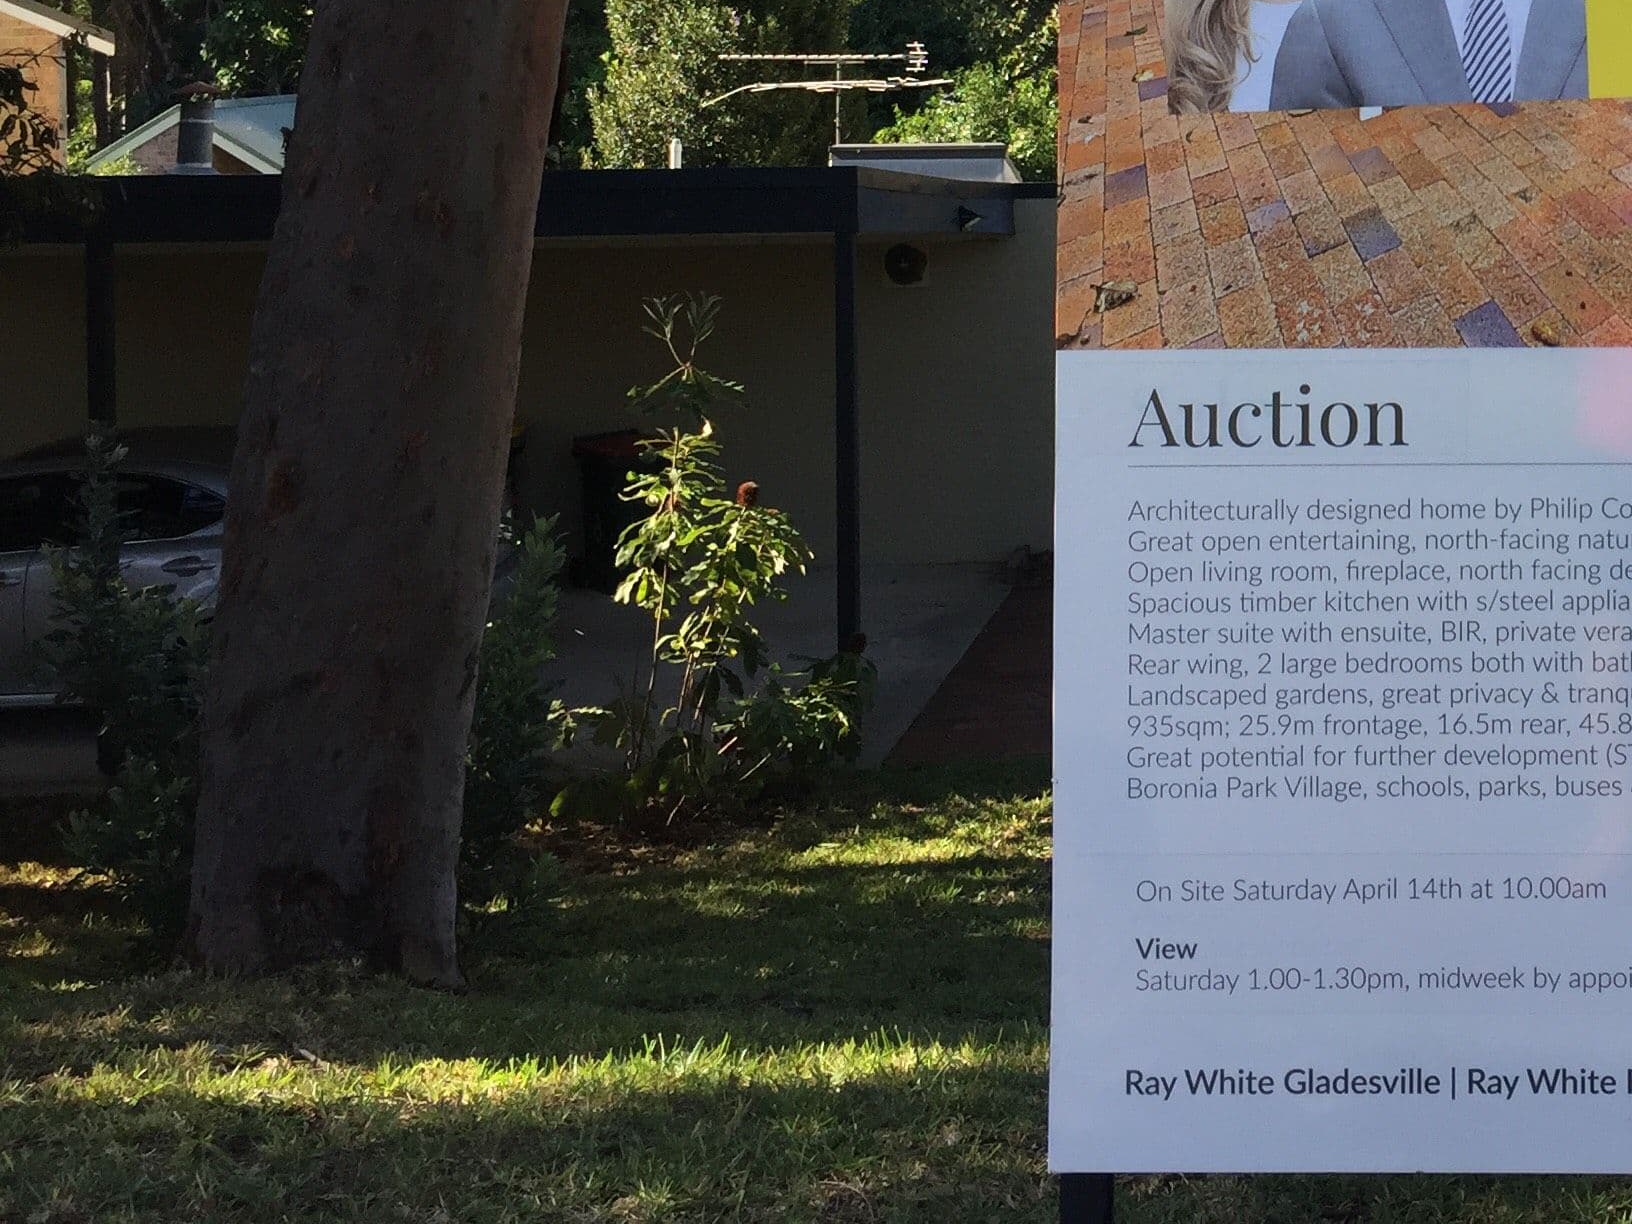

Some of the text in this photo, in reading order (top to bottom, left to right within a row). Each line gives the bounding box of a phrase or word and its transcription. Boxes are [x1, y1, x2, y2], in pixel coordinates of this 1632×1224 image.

[1127, 383, 1409, 449] Auction
[1127, 498, 1300, 525] Architecturally
[1306, 497, 1411, 525] designed
[1420, 497, 1486, 520] home
[1495, 497, 1523, 524] by
[1530, 496, 1593, 524] Philip
[1128, 530, 1194, 553] Great
[1201, 535, 1261, 556] open
[1269, 528, 1416, 556] entertaining,
[1425, 527, 1570, 555] north-facing
[1128, 561, 1193, 587] Open
[1202, 560, 1263, 587] living
[1271, 565, 1338, 585] room,
[1346, 559, 1451, 586] fireplace,
[1459, 558, 1523, 581] north
[1531, 558, 1602, 586] facing
[1128, 591, 1232, 618] Spacious
[1240, 590, 1317, 614] timber
[1324, 589, 1409, 613] kitchen
[1416, 589, 1468, 612] with
[1476, 589, 1554, 612] s/steel
[1128, 622, 1209, 645] Master
[1217, 621, 1274, 644] suite
[1281, 621, 1332, 644] with
[1340, 620, 1432, 645] ensuite,
[1441, 620, 1487, 645] BIR,
[1495, 620, 1577, 647] private
[1128, 653, 1181, 676] Rear
[1187, 652, 1249, 680] wing,
[1257, 652, 1272, 675] 2
[1281, 652, 1337, 679] large
[1345, 651, 1463, 674] bedrooms
[1471, 650, 1525, 674] both
[1532, 650, 1583, 673] with
[1128, 682, 1267, 710] Landscaped
[1275, 682, 1373, 710] gardens,
[1381, 683, 1442, 710] great
[1450, 682, 1534, 709] privacy
[1541, 681, 1560, 704] &
[1127, 715, 1230, 742] 935sqm;
[1239, 714, 1314, 737] 25.9m
[1323, 713, 1428, 741] frontage,
[1438, 712, 1512, 735] 16.5m
[1520, 718, 1571, 738] rear,
[1126, 746, 1193, 769] Great
[1201, 744, 1304, 773] potential
[1313, 744, 1347, 767] for
[1353, 743, 1437, 767] further
[1443, 743, 1599, 771] development
[1127, 776, 1217, 800] Boronia
[1227, 775, 1277, 799] Park
[1284, 775, 1368, 803] Village,
[1376, 774, 1470, 800] schools,
[1479, 774, 1547, 802] parks,
[1555, 774, 1623, 797] buses
[1136, 876, 1607, 905] On Site Saturday April 14th at 10.00am
[1135, 937, 1198, 960] View
[1136, 967, 1240, 996] Saturday
[1248, 966, 1410, 994] 1.00-1.30pm,
[1418, 966, 1525, 989] midweek
[1533, 966, 1562, 994] by
[1126, 1069, 1178, 1101] Ray
[1184, 1068, 1275, 1095] White
[1283, 1067, 1441, 1095] Gladesville
[1468, 1068, 1520, 1101] Ray
[1526, 1067, 1617, 1095] White
